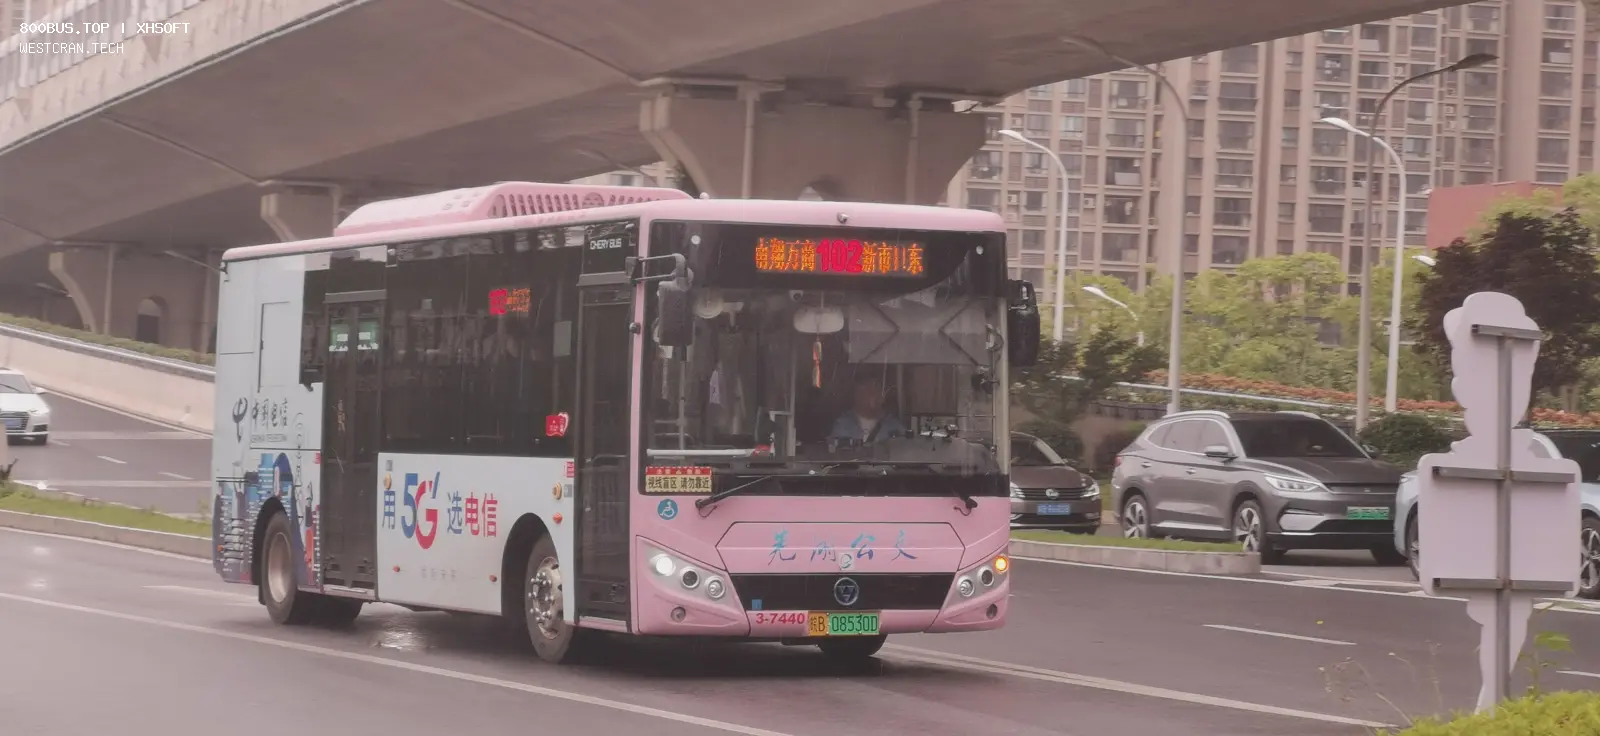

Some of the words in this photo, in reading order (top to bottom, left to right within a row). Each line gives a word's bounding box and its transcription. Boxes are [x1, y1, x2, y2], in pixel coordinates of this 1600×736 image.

[590, 239, 608, 250] CHERY
[609, 238, 622, 249] BUS
[816, 239, 864, 273] 102
[648, 476, 677, 489] 视线盲区
[680, 476, 710, 489] 请勿靠近
[401, 471, 440, 549] 5G
[447, 491, 498, 537] 选电信
[767, 529, 918, 567] 芜湖公交
[755, 612, 806, 625] 3-7440
[831, 615, 879, 633] 08530D
